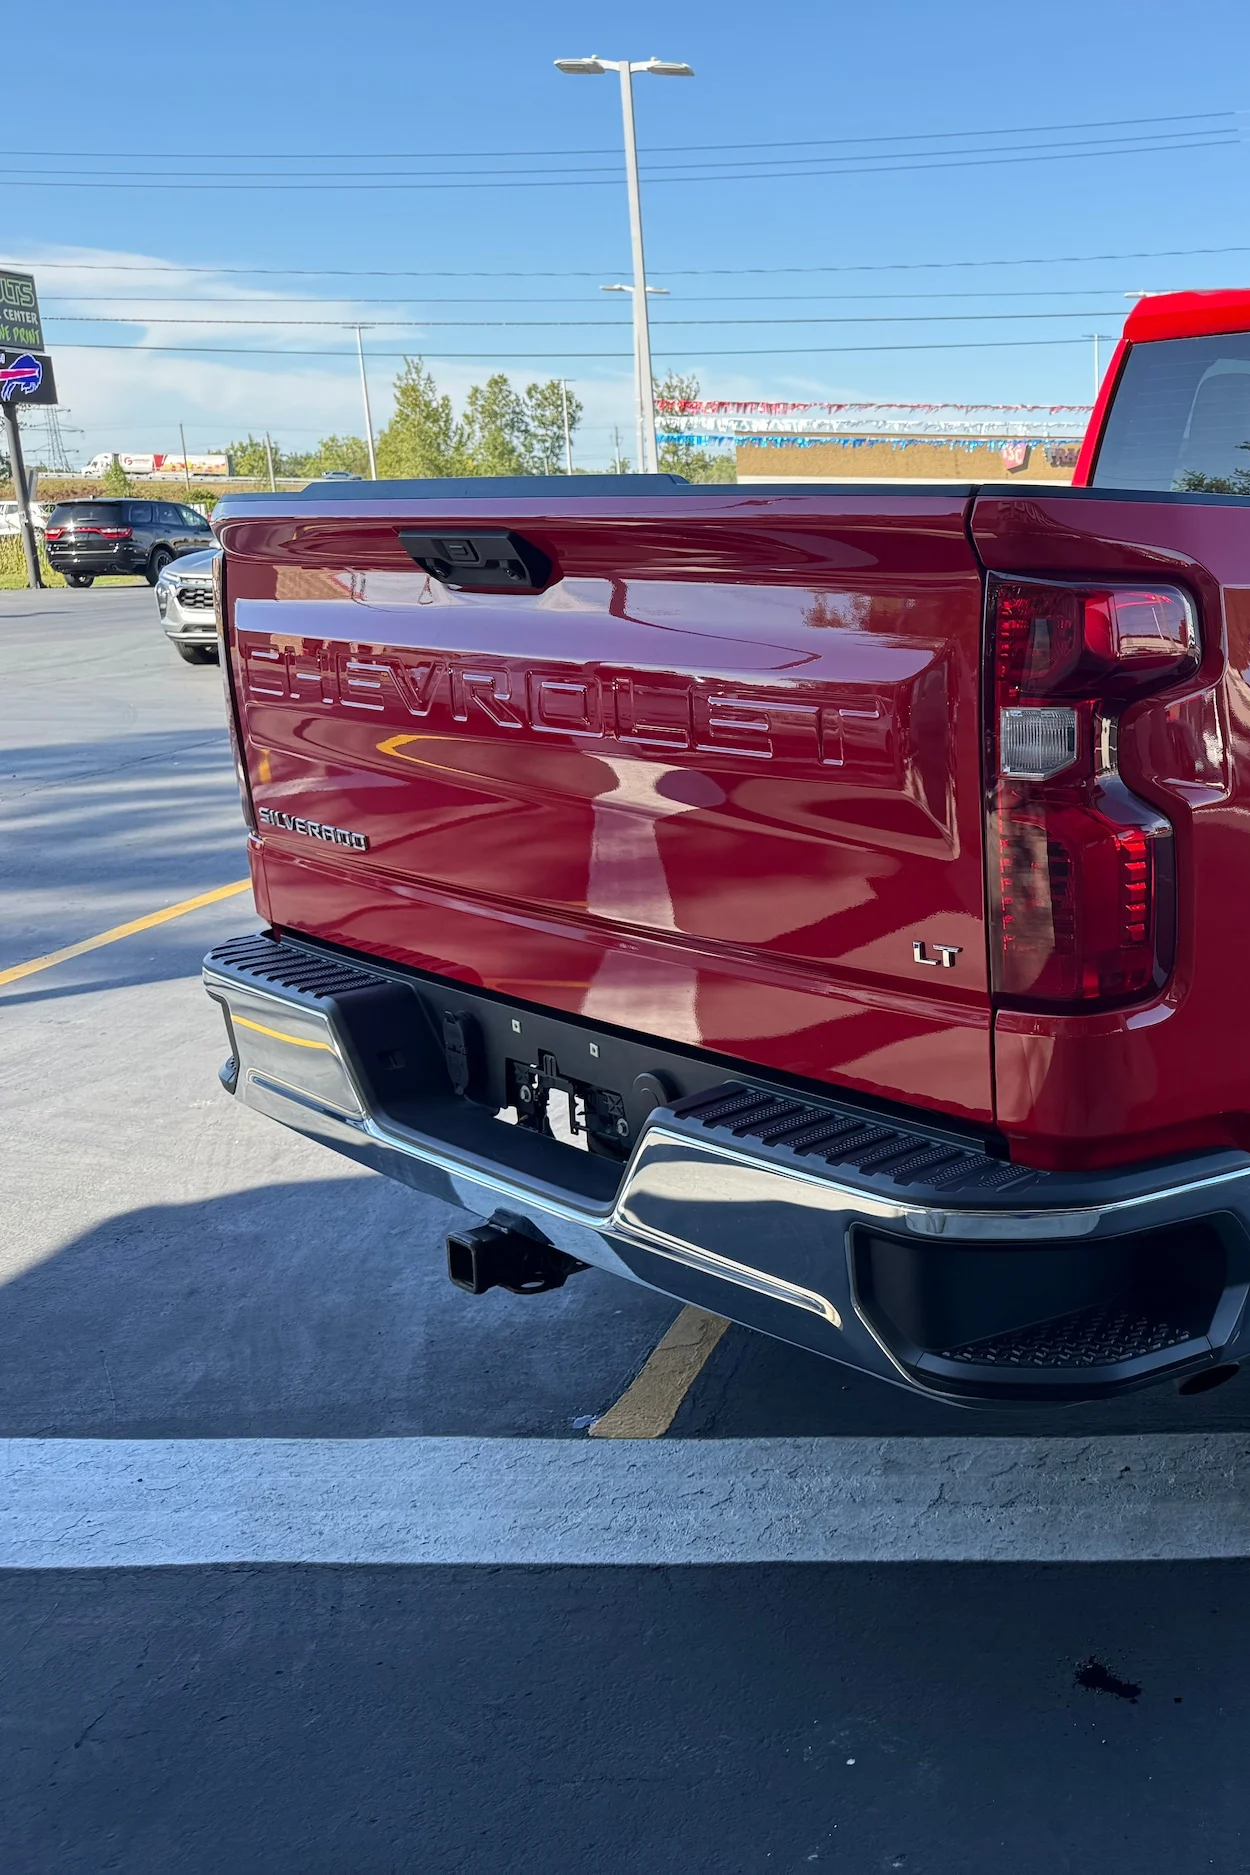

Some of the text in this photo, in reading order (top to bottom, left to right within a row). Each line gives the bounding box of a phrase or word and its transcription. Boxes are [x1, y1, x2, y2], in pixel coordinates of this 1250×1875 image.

[3, 308, 38, 325] CENTER
[245, 642, 882, 767] CHEVROLET
[258, 806, 370, 851] SILVERADO
[912, 940, 963, 968] LT
